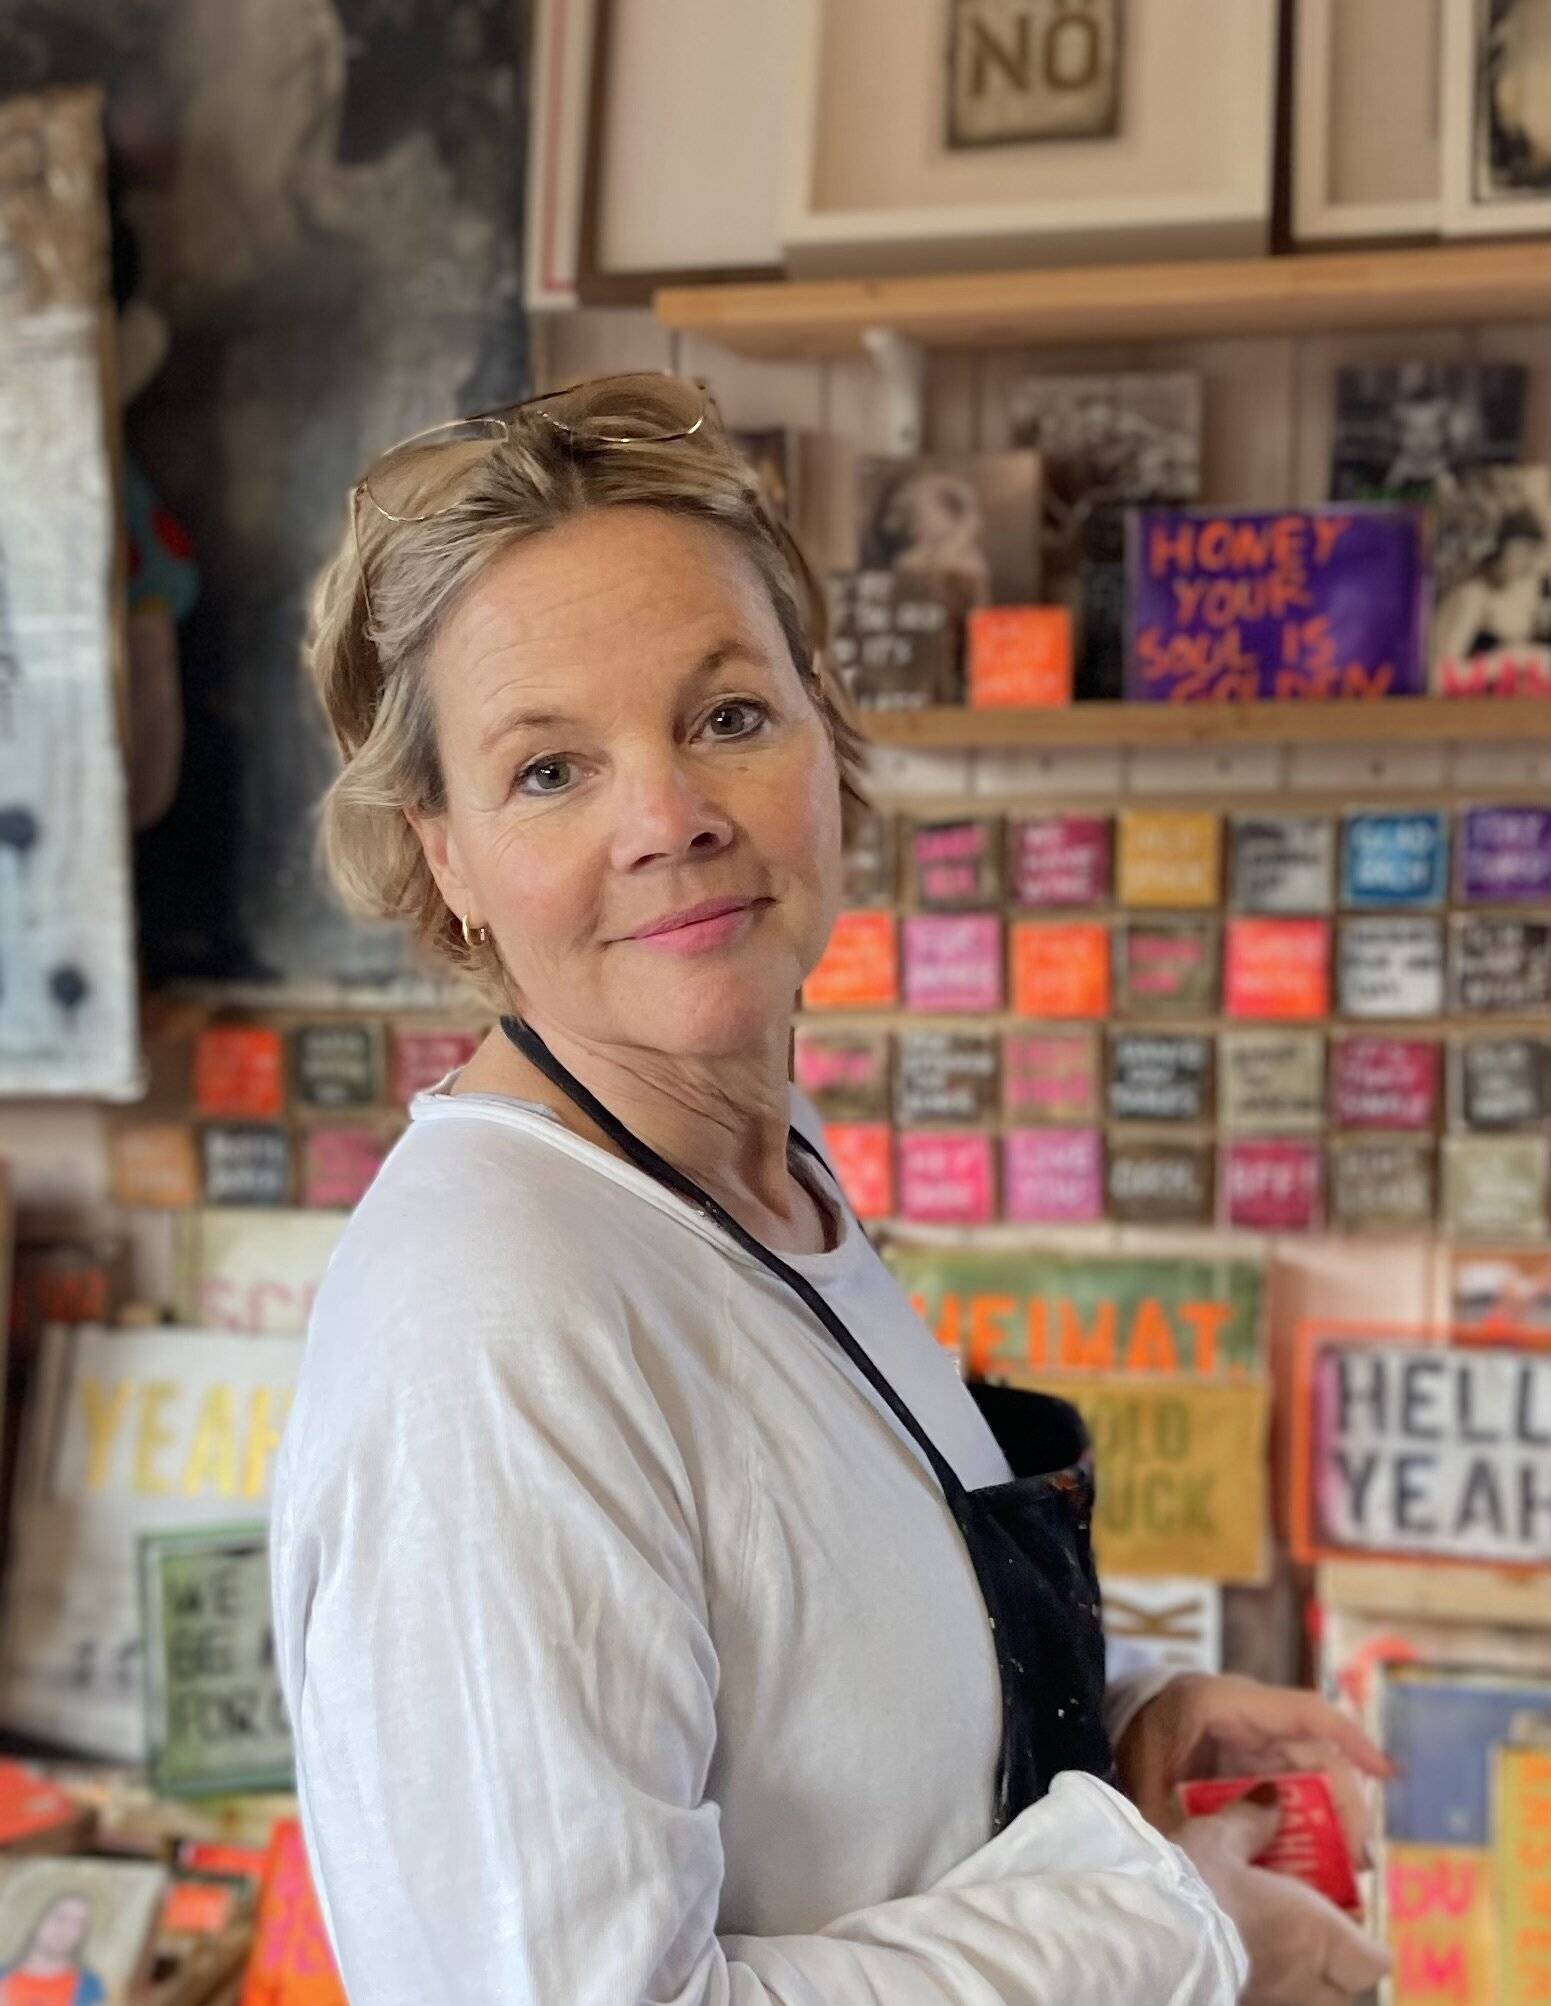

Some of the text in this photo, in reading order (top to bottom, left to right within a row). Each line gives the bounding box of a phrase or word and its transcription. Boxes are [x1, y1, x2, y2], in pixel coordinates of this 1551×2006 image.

[1149, 514, 1353, 577] HONEY
[1172, 560, 1311, 627] YOUR
[1136, 616, 1338, 683] SOUL IS
[1336, 1353, 1551, 1447] HELL
